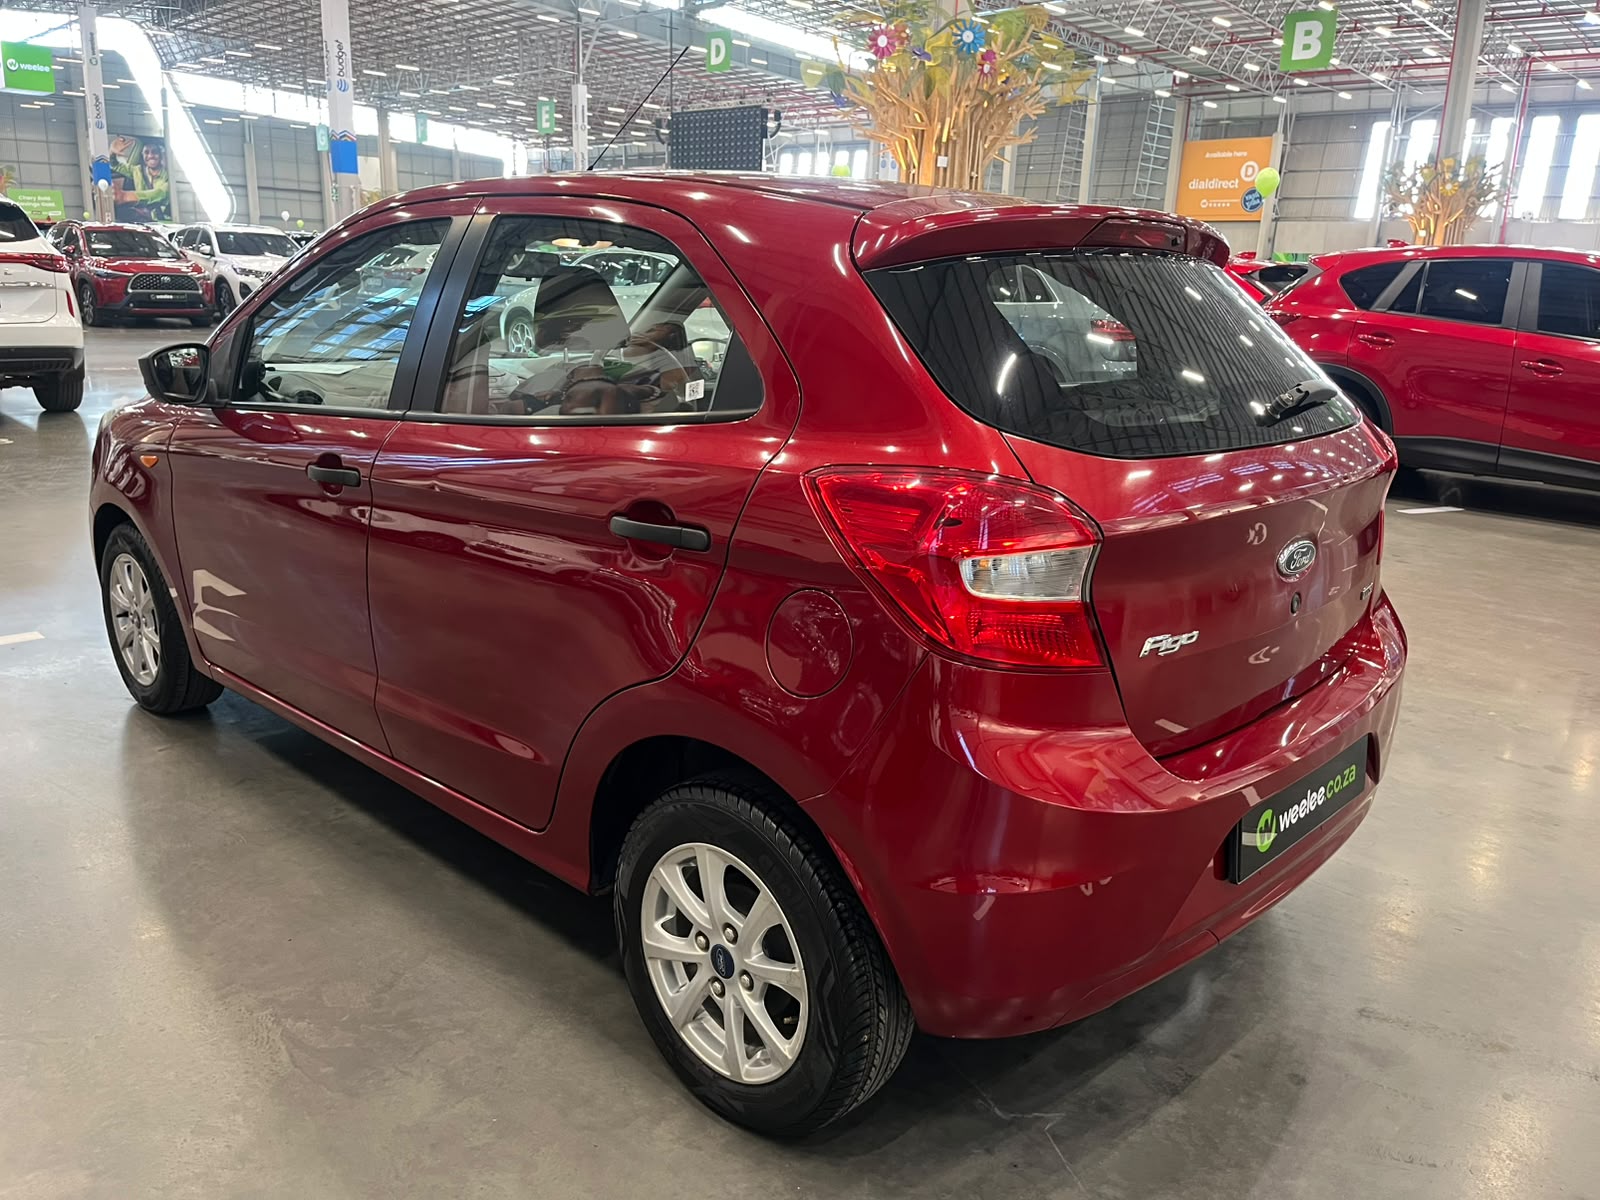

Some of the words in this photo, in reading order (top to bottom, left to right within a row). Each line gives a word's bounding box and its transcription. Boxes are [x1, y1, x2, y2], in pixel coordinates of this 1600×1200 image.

[710, 37, 726, 66] D
[1291, 20, 1324, 61] B
[19, 63, 50, 73] weelee
[336, 39, 347, 78] budget
[541, 105, 551, 129] E
[1188, 178, 1239, 190] dialdirect
[1139, 630, 1200, 658] Figo
[1279, 764, 1357, 832] weelee.co.za
